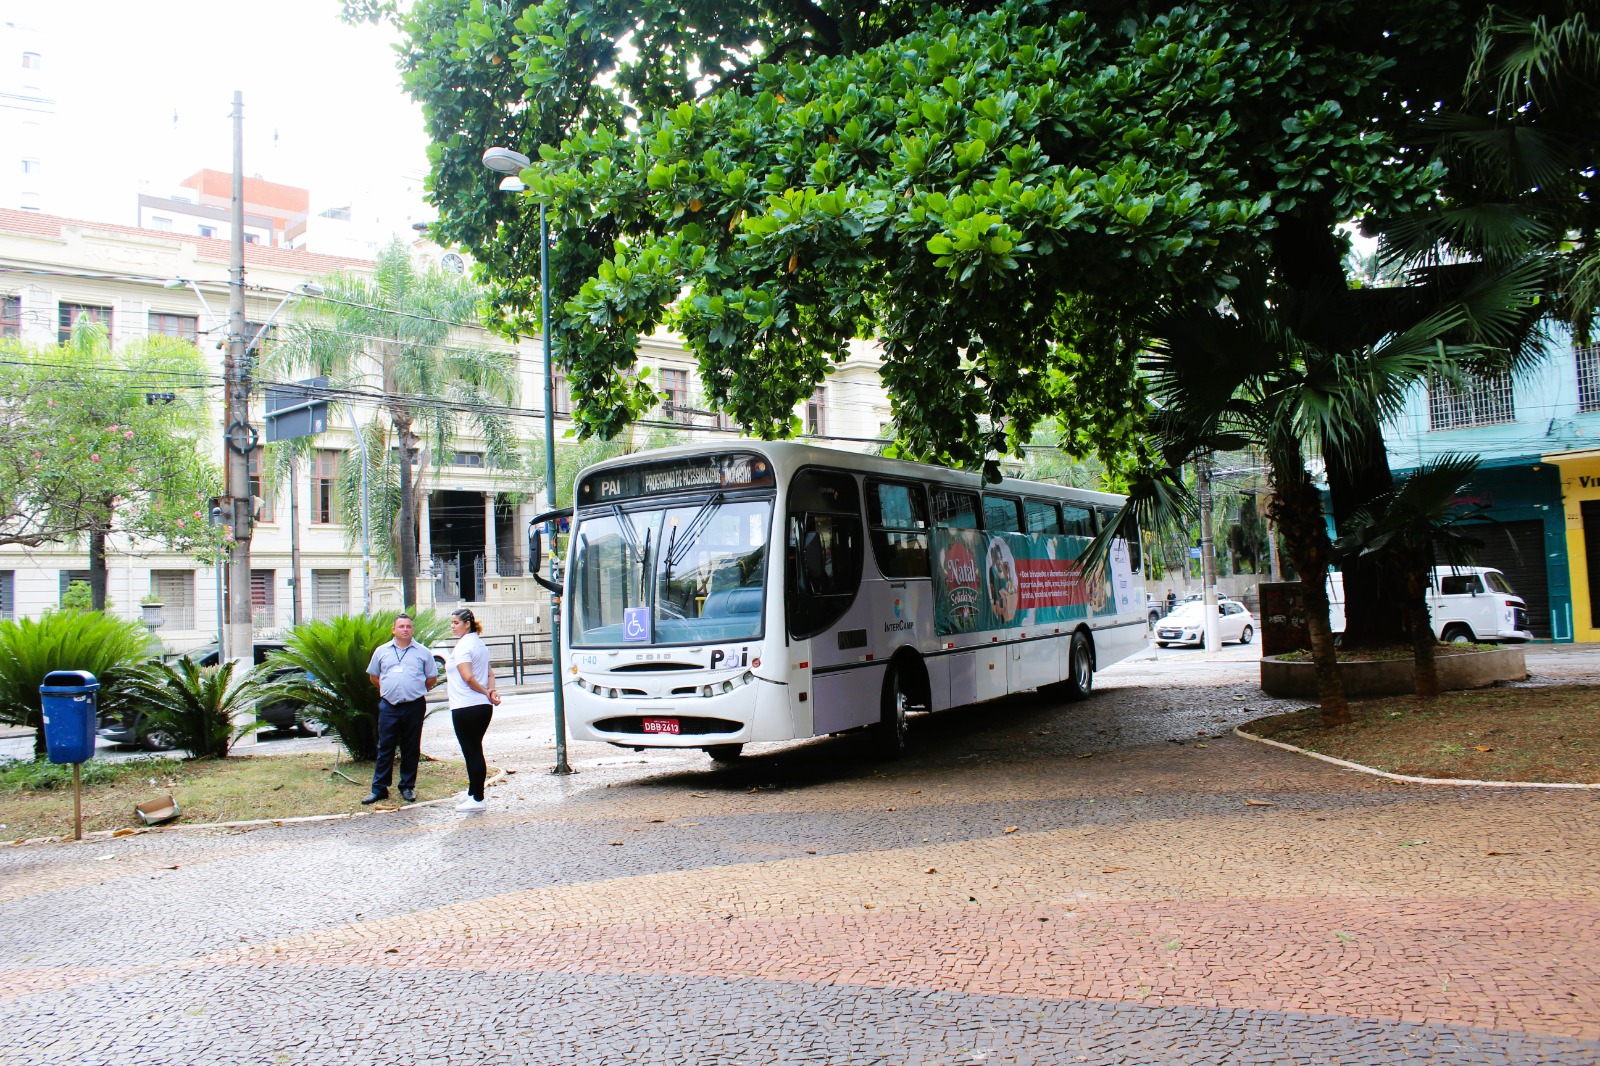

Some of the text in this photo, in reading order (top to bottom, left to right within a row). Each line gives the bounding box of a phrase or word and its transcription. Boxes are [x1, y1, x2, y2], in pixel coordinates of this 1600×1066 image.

[601, 480, 621, 496] PAI
[675, 469, 683, 487] DE
[947, 558, 976, 585] Natal
[644, 722, 680, 732] DBB-2613
